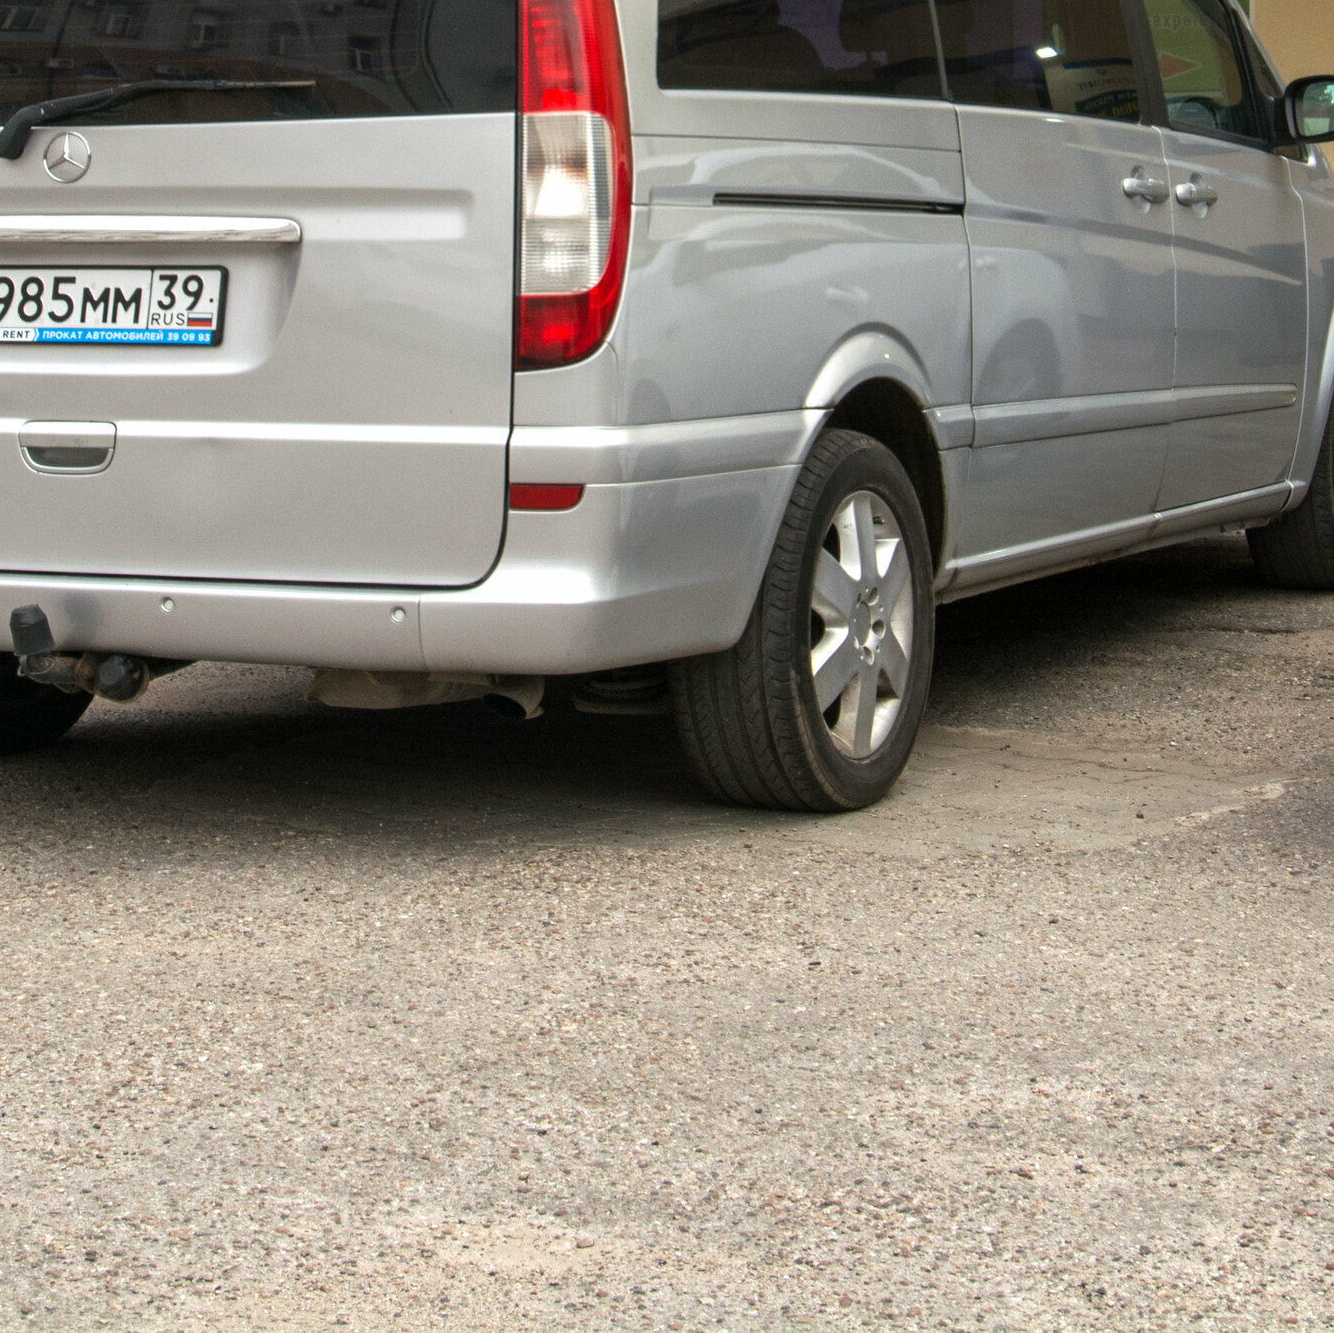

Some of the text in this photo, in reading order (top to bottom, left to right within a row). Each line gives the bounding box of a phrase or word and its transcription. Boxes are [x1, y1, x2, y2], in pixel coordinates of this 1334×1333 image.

[157, 274, 204, 310] 39
[150, 312, 185, 326] RUS
[3, 330, 31, 339] RENT
[43, 330, 210, 342] ПРОКАТ АВТОМОБИЛЕЙ 39 09 93
